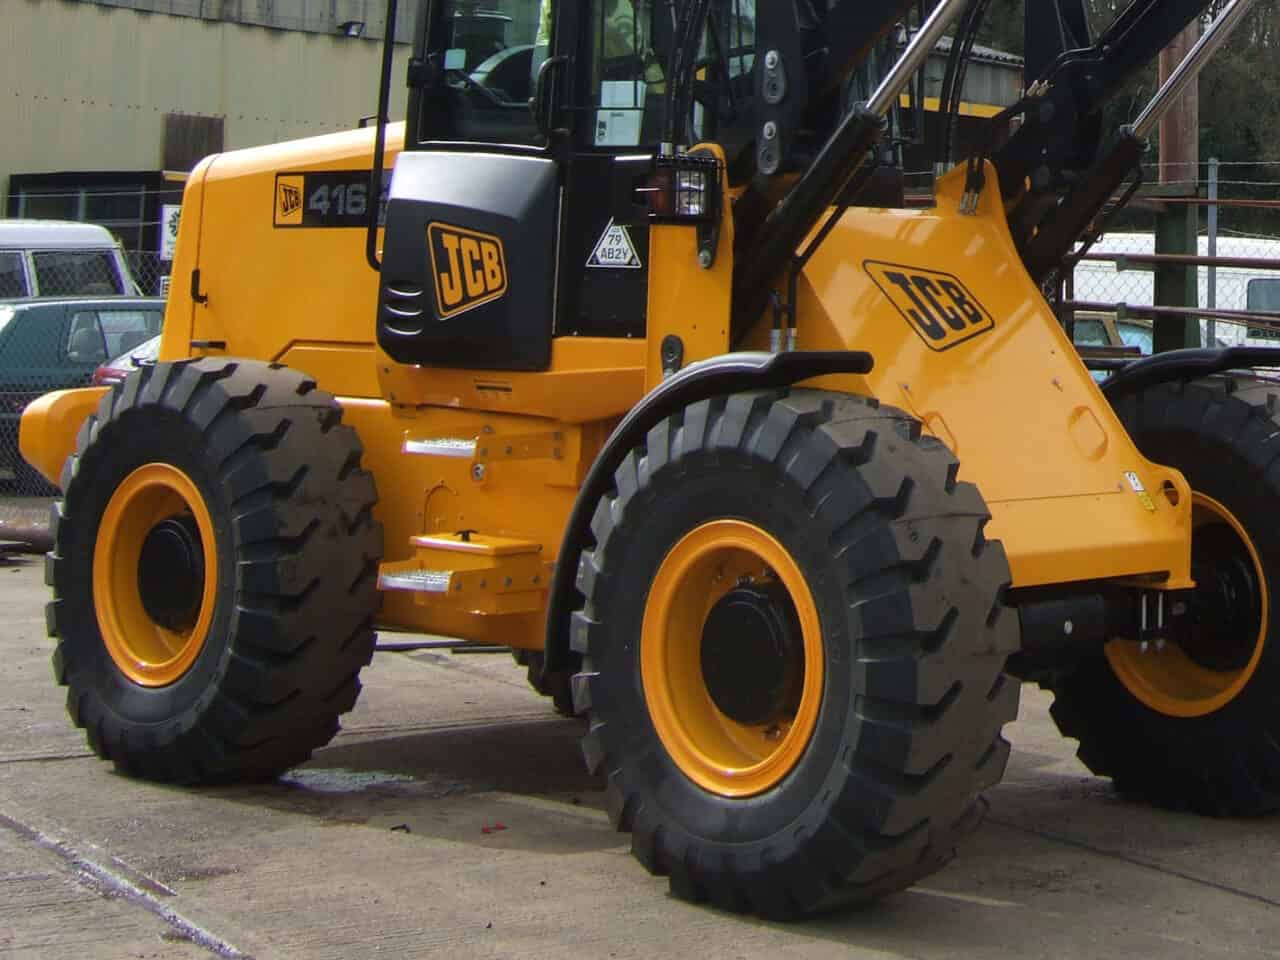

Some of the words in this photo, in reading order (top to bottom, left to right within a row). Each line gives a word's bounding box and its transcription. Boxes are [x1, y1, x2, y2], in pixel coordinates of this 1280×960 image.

[282, 187, 299, 212] JCB
[309, 184, 367, 215] 416
[440, 232, 502, 305] JCB
[882, 271, 983, 340] JCB
